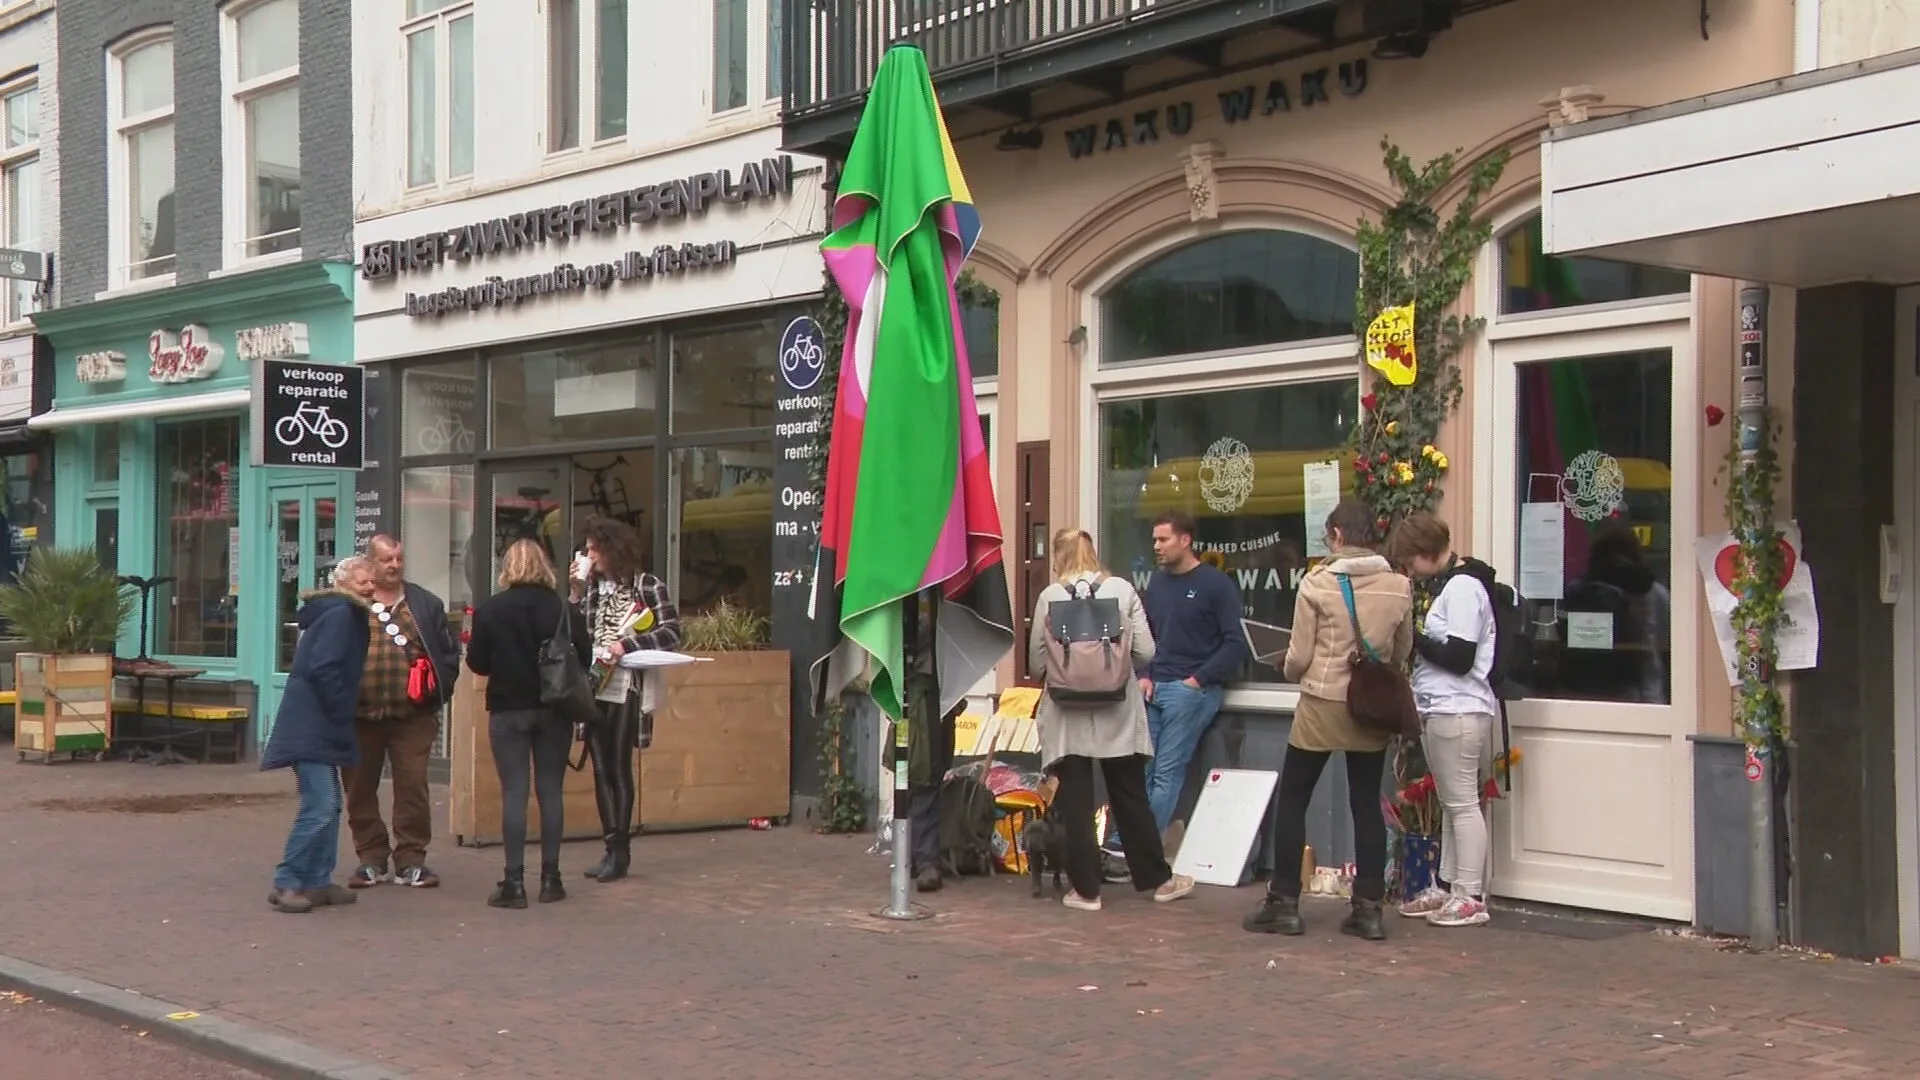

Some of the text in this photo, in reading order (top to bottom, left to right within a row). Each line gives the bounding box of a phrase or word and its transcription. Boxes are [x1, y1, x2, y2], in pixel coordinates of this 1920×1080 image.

[1065, 57, 1368, 159] WAKU WAKU
[394, 230, 444, 276] HET
[466, 262, 583, 311] prijsgarantie
[584, 262, 614, 290] op
[612, 250, 652, 282] alle
[651, 239, 737, 275] fietsen
[282, 367, 345, 384] verkoop
[278, 384, 348, 399] reparatie
[775, 419, 820, 439] reparat
[291, 451, 336, 464] rental
[775, 521, 798, 536] ma
[1206, 542, 1238, 554] BASED
[1239, 531, 1281, 552] CUISINE
[774, 571, 791, 586] za
[1236, 567, 1306, 591] WAK
